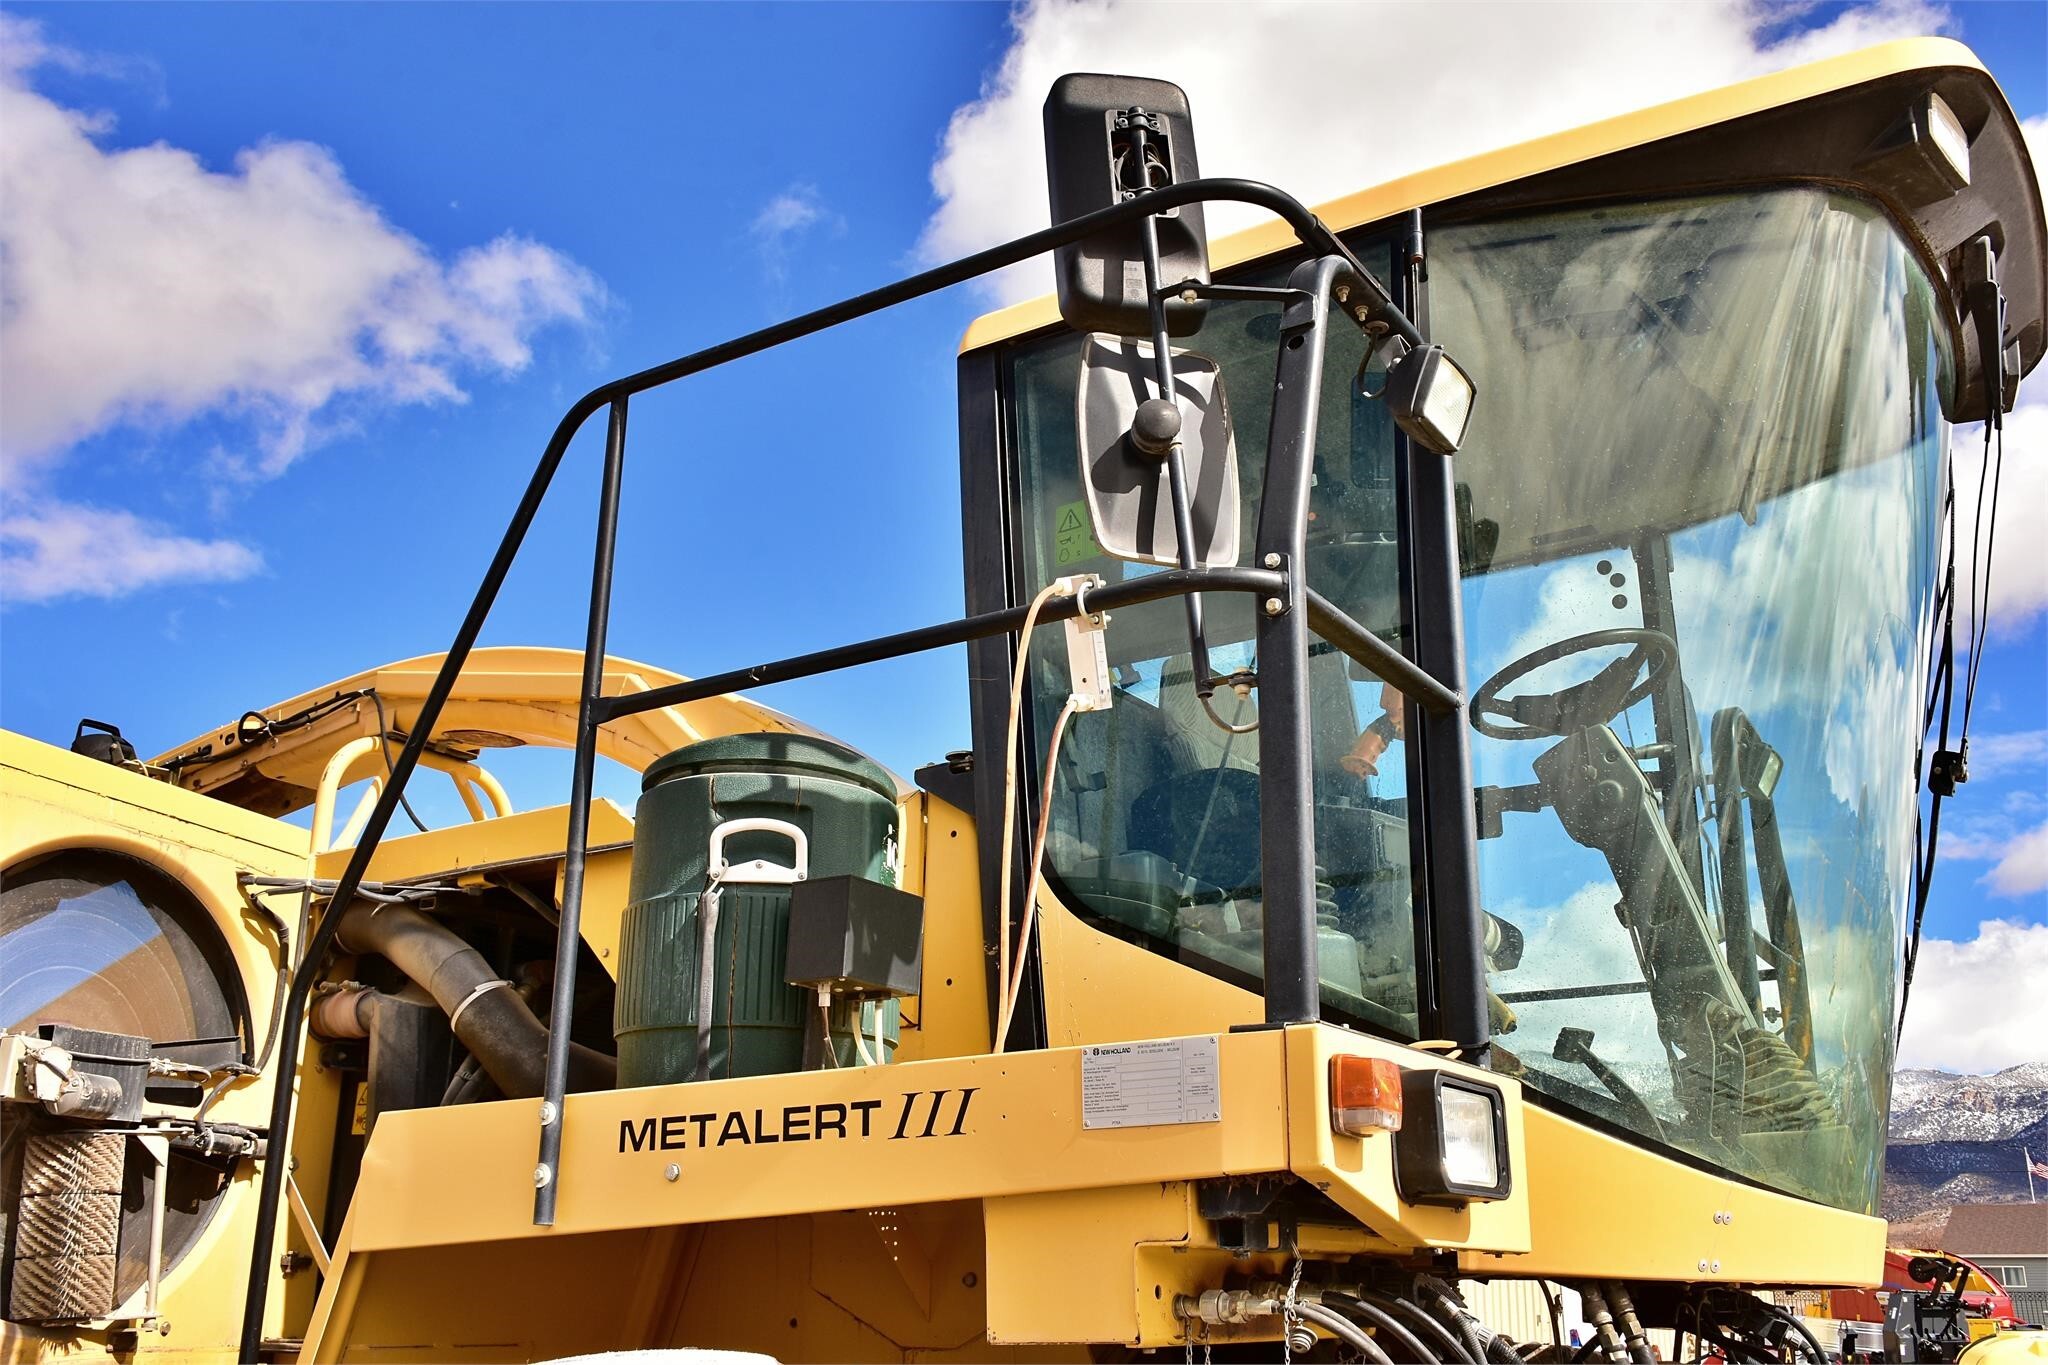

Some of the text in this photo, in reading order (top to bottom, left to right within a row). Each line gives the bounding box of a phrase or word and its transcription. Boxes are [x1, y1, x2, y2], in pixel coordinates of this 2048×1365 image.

[1100, 1048, 1111, 1056] NEW
[1111, 1047, 1131, 1055] HOLLAND
[618, 1087, 981, 1153] METALERT III
